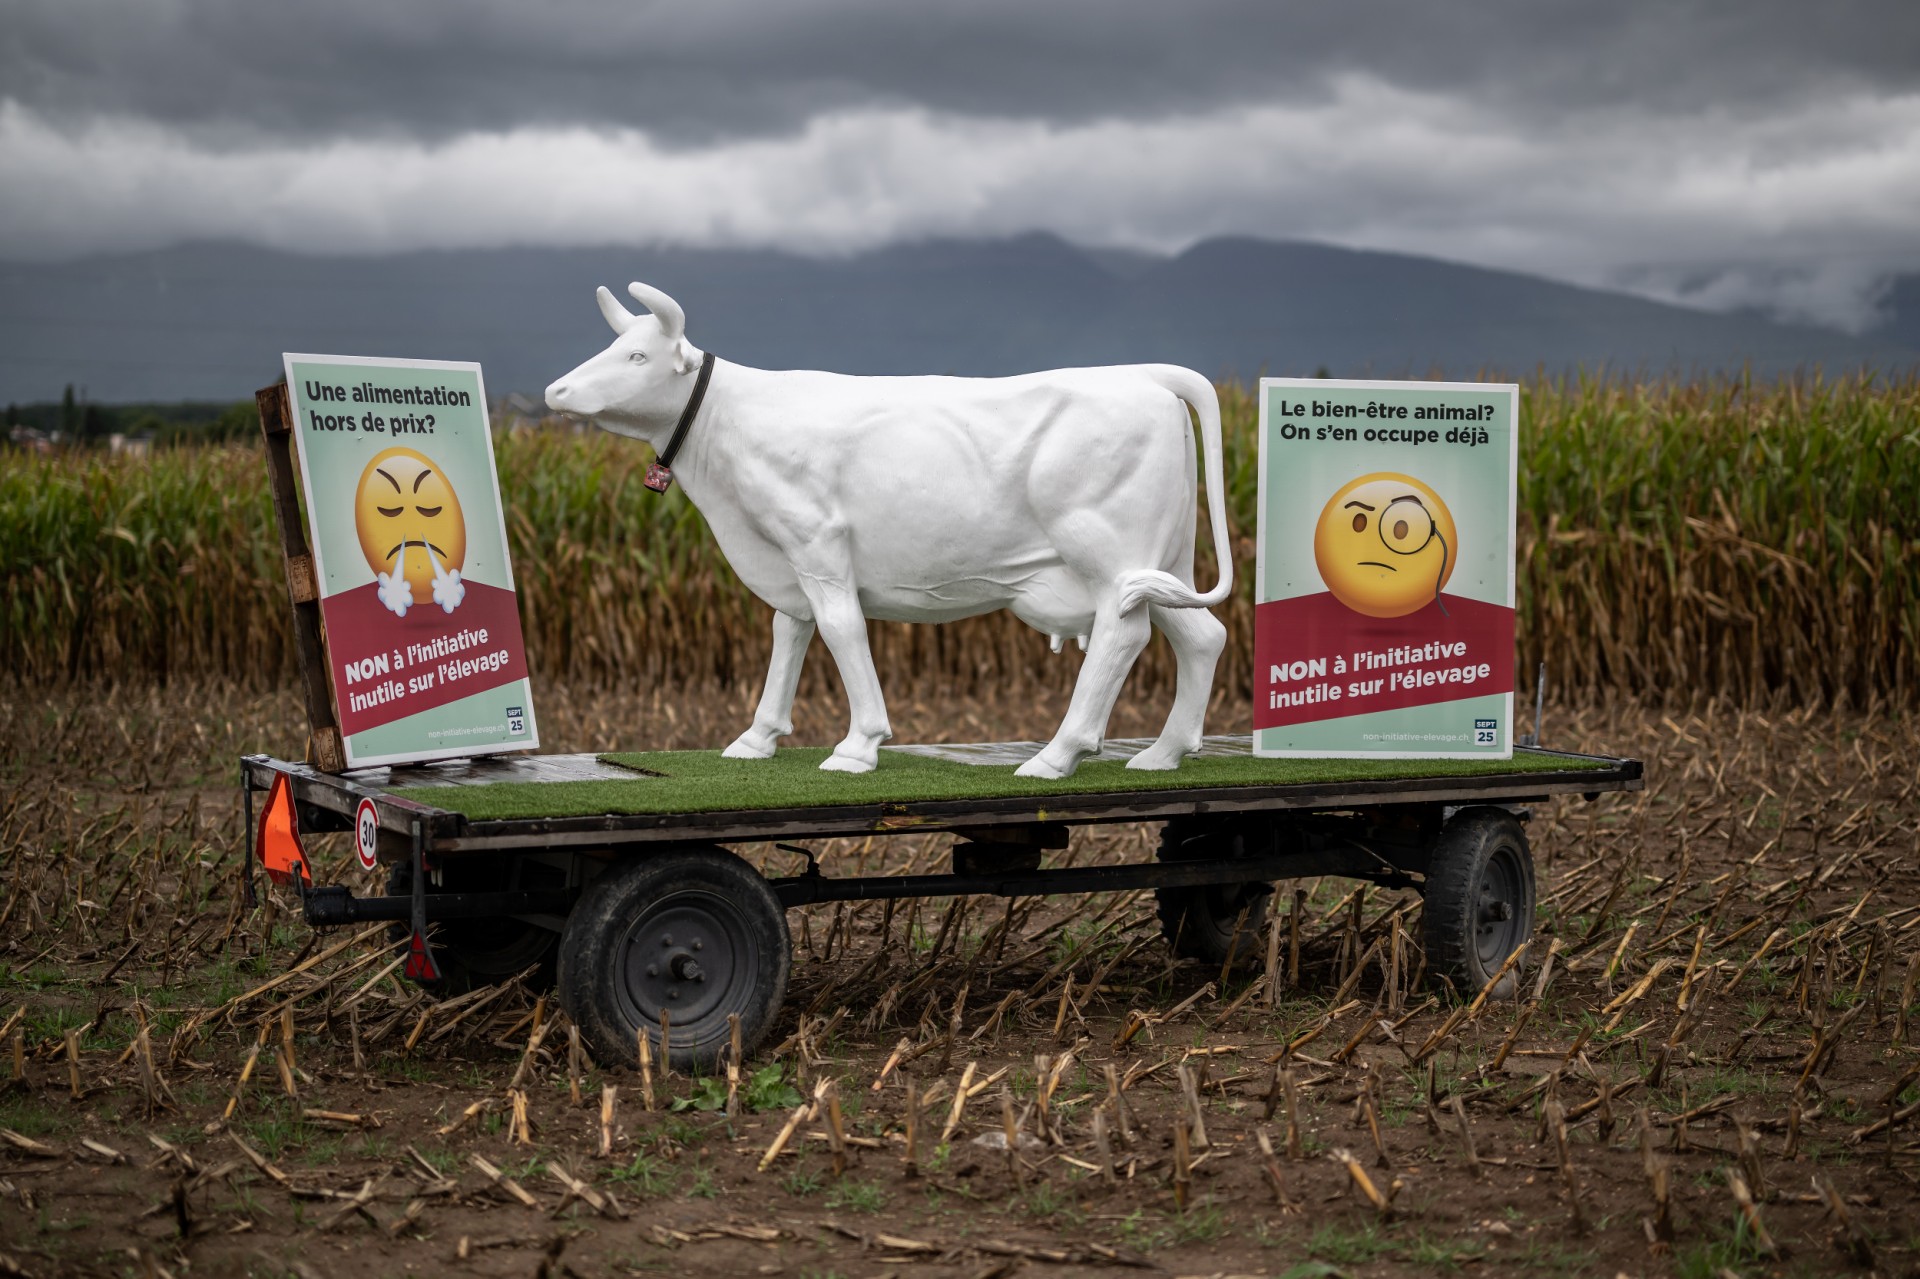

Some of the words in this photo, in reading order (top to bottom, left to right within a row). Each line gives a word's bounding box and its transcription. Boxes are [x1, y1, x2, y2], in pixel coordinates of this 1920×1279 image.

[305, 380, 347, 402] Une
[352, 382, 471, 406] alimentation
[1281, 400, 1306, 417] Le
[1312, 400, 1408, 419] bien-être
[1414, 403, 1495, 421] animal?
[310, 410, 357, 432] hors
[361, 411, 385, 432] de
[389, 413, 436, 437] prix?
[1280, 423, 1310, 440] On
[1316, 425, 1358, 441] s’en
[1363, 429, 1439, 446] occupe
[1445, 427, 1489, 447] déjà
[344, 653, 390, 685] NON
[393, 649, 405, 671] à
[406, 628, 489, 666] l’initiative
[1270, 657, 1327, 684] NON
[1333, 655, 1347, 675] à
[1353, 641, 1467, 672] l’initiative
[349, 679, 405, 713] inutile
[408, 672, 435, 694] sur
[437, 649, 509, 685] l’élevage
[1269, 683, 1342, 709] inutile
[1347, 677, 1384, 698] sur
[1389, 663, 1491, 691] l’élevage
[508, 708, 521, 716] SEPT
[428, 724, 505, 738] non-initiative-elevage.ch
[511, 720, 523, 731] 25
[1363, 732, 1469, 743] non-initiative-elevage.ch
[1477, 731, 1494, 742] 25
[362, 820, 374, 848] 30
